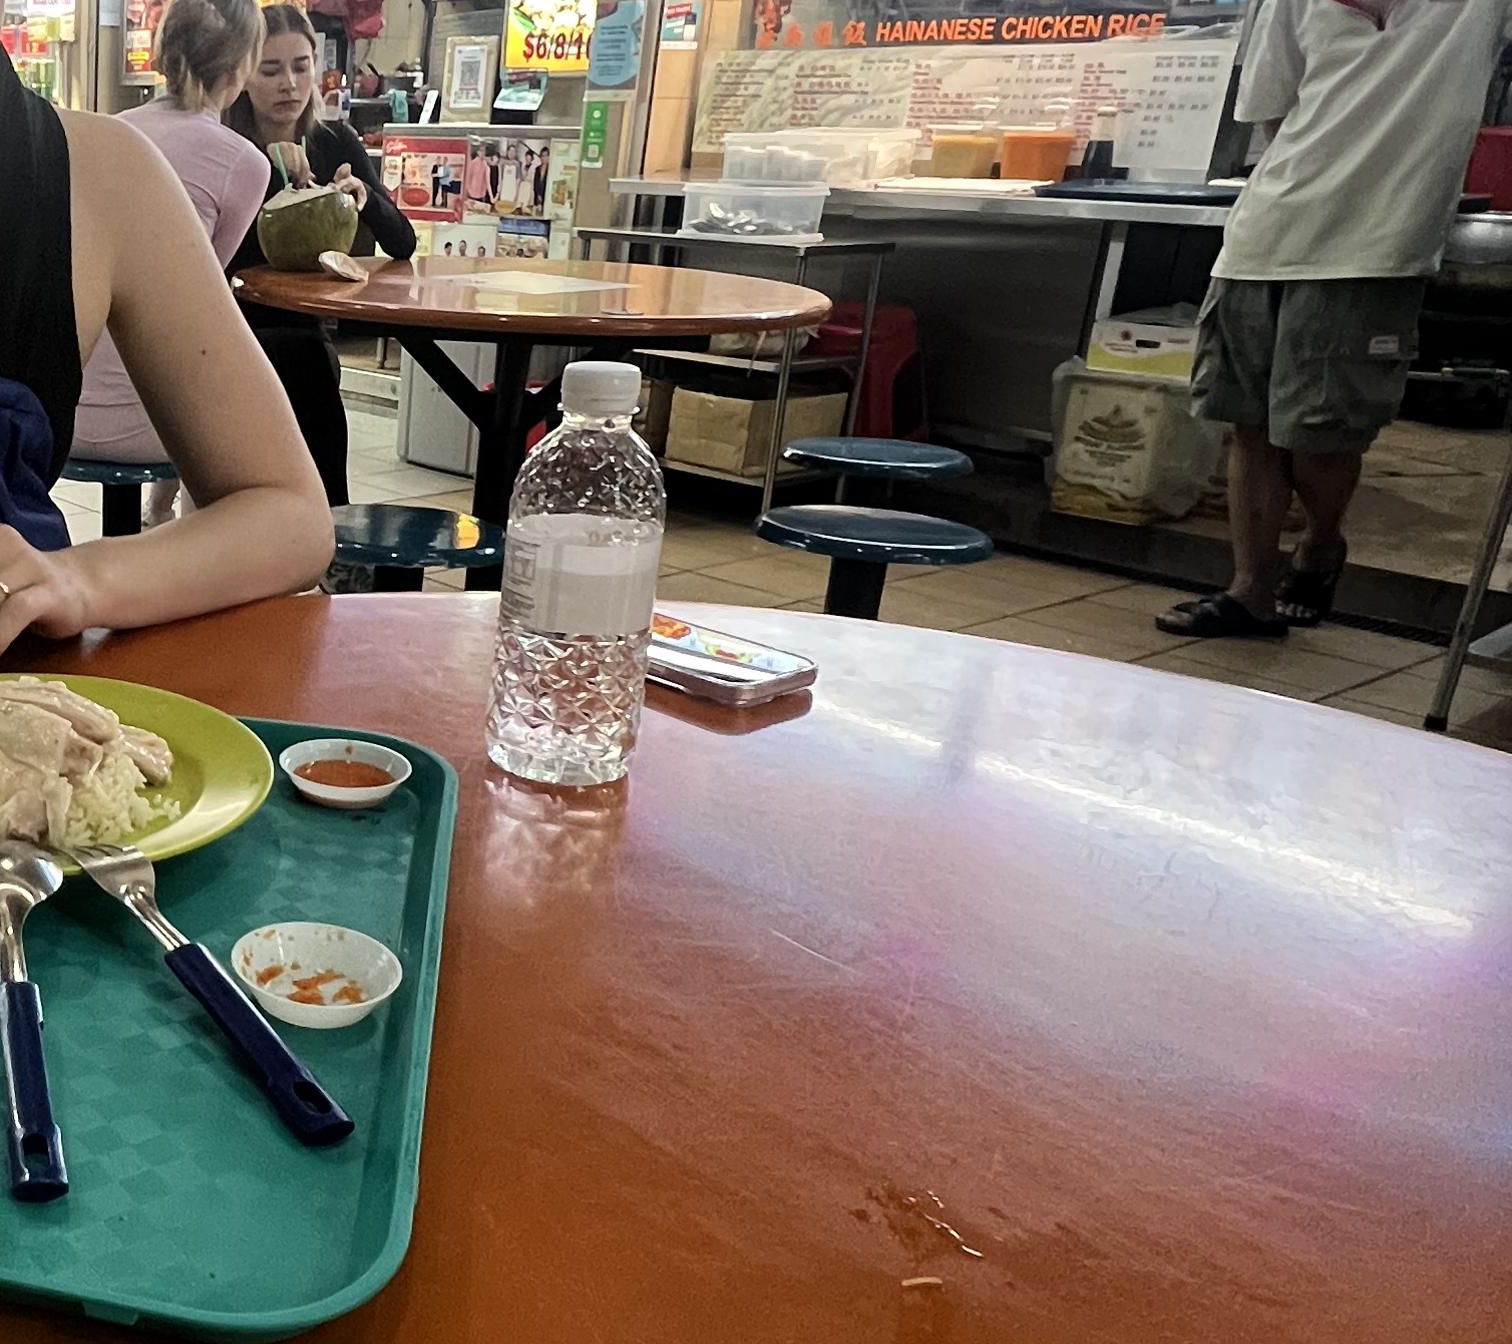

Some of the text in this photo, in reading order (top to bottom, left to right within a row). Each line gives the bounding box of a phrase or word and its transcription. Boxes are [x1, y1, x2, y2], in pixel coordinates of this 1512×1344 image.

[876, 13, 1167, 42] HAINANESE CHICKEN RICE
